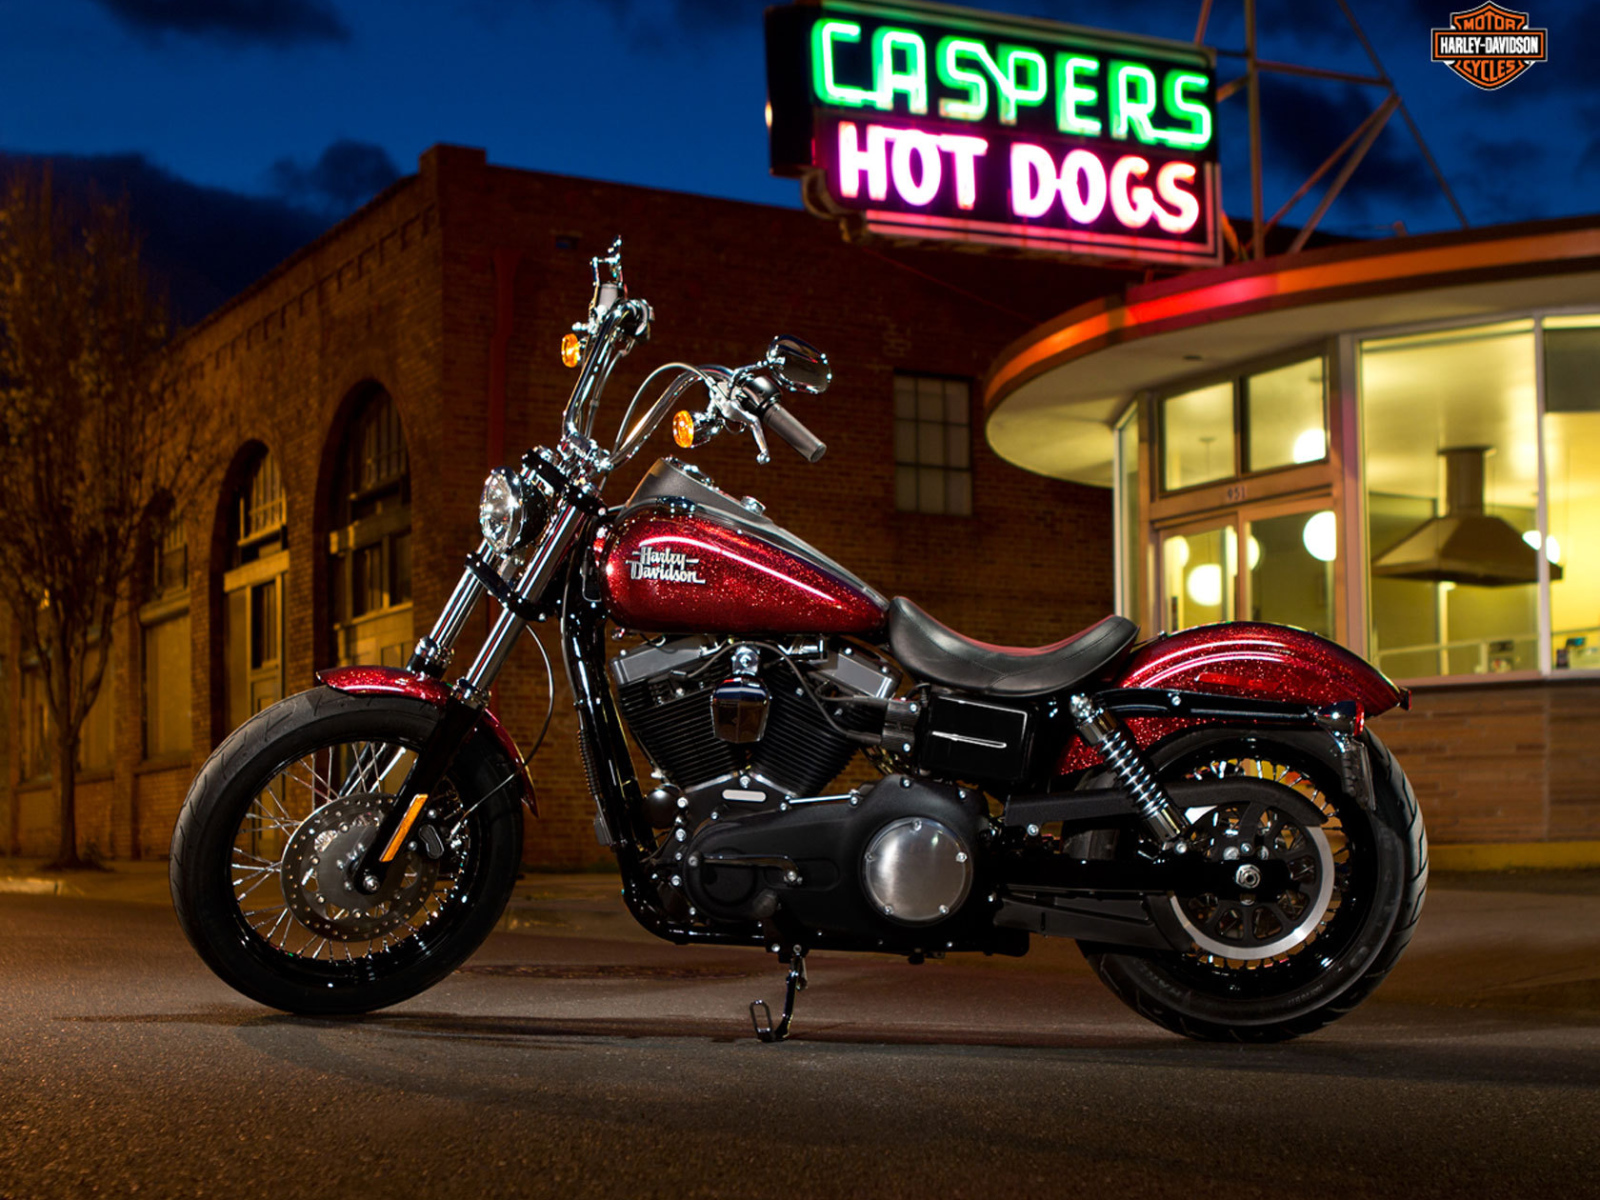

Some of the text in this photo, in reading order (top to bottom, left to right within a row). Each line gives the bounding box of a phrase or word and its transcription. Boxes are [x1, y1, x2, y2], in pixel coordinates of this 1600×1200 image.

[812, 18, 1212, 150] CASPERS
[838, 121, 1199, 234] HOT DOGS
[625, 559, 706, 584] Davidson
